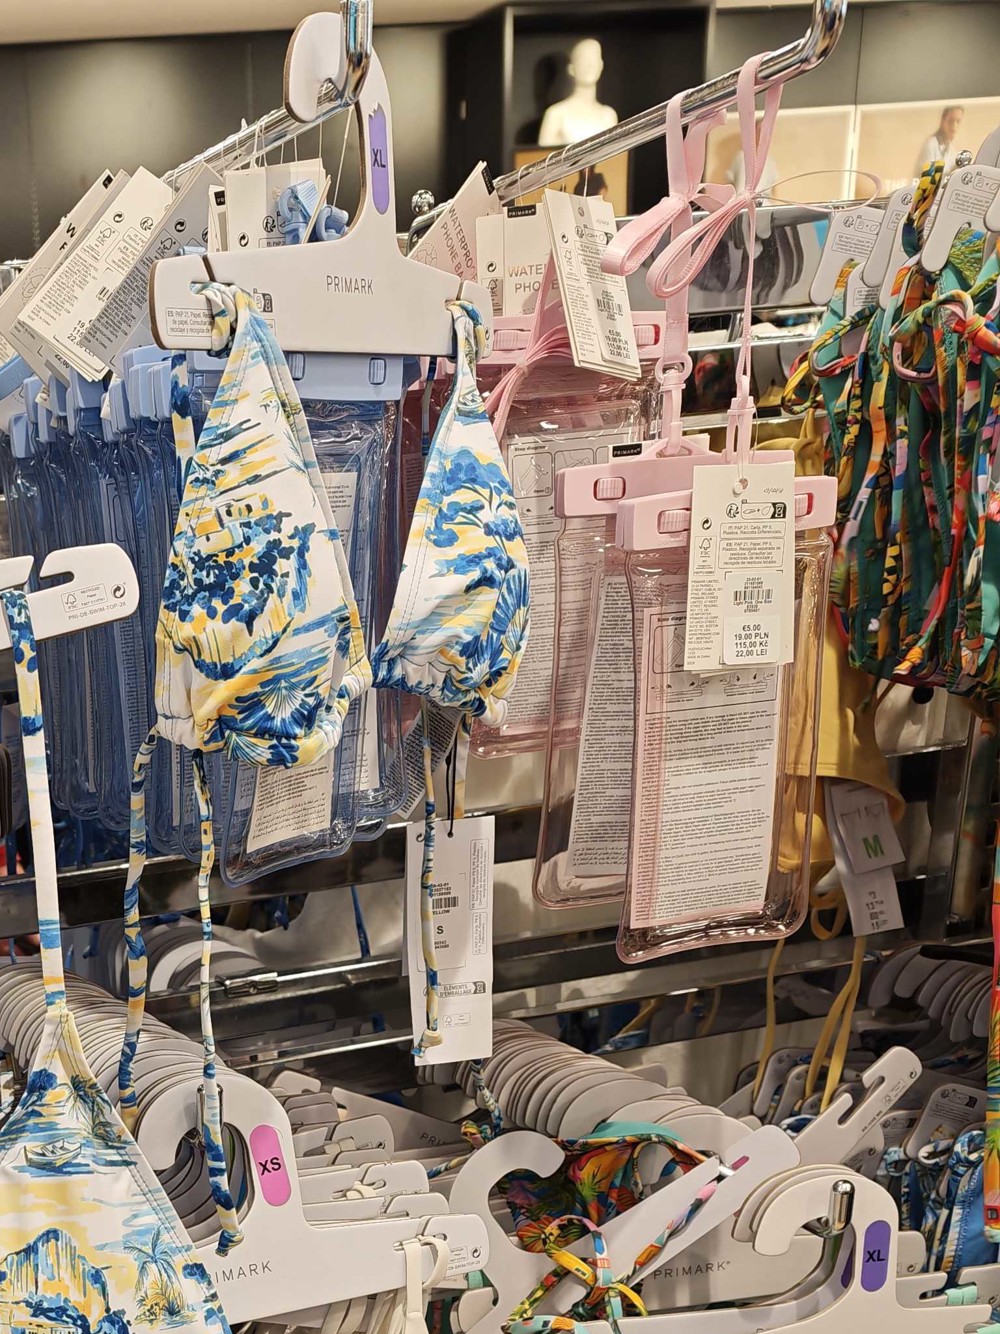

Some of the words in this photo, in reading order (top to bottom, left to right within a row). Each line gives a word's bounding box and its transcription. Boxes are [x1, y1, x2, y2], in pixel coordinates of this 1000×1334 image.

[372, 148, 386, 169] XL
[441, 222, 459, 261] PHONE
[326, 274, 374, 295] PRIMARK
[734, 632, 753, 641] 19.00
[754, 632, 769, 640] PLN
[742, 624, 761, 632] €5.00
[735, 649, 754, 658] 22,00
[755, 648, 768, 656] LEI
[862, 834, 885, 860] M
[436, 925, 444, 935] S
[258, 1156, 282, 1176] XS
[865, 1248, 886, 1263] XL
[209, 1260, 274, 1285] IMARK
